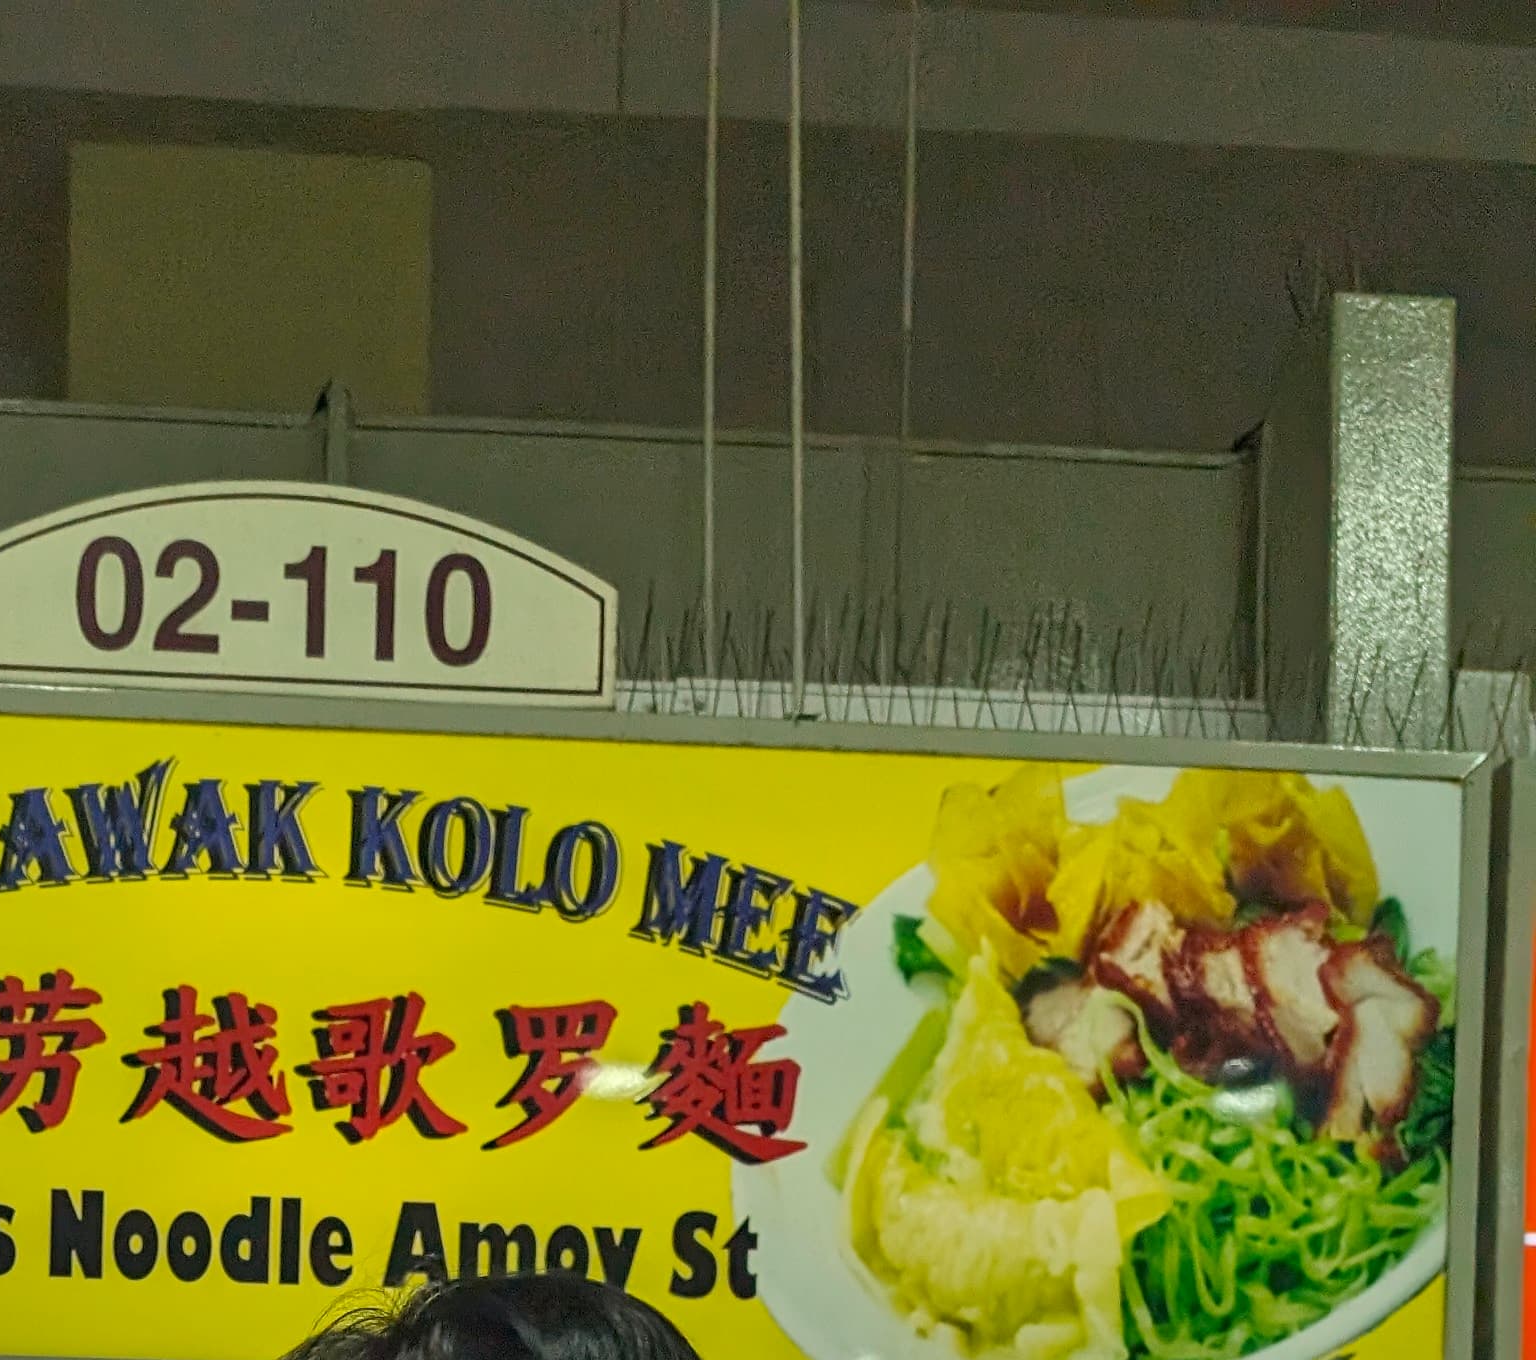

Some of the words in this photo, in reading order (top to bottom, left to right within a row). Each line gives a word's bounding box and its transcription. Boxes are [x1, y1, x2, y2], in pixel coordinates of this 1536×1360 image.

[77, 535, 491, 666] 02-110
[342, 785, 622, 923] KOLO
[629, 839, 861, 1005] MEE
[49, 1188, 355, 1287] Noodle
[668, 1209, 760, 1300] St
